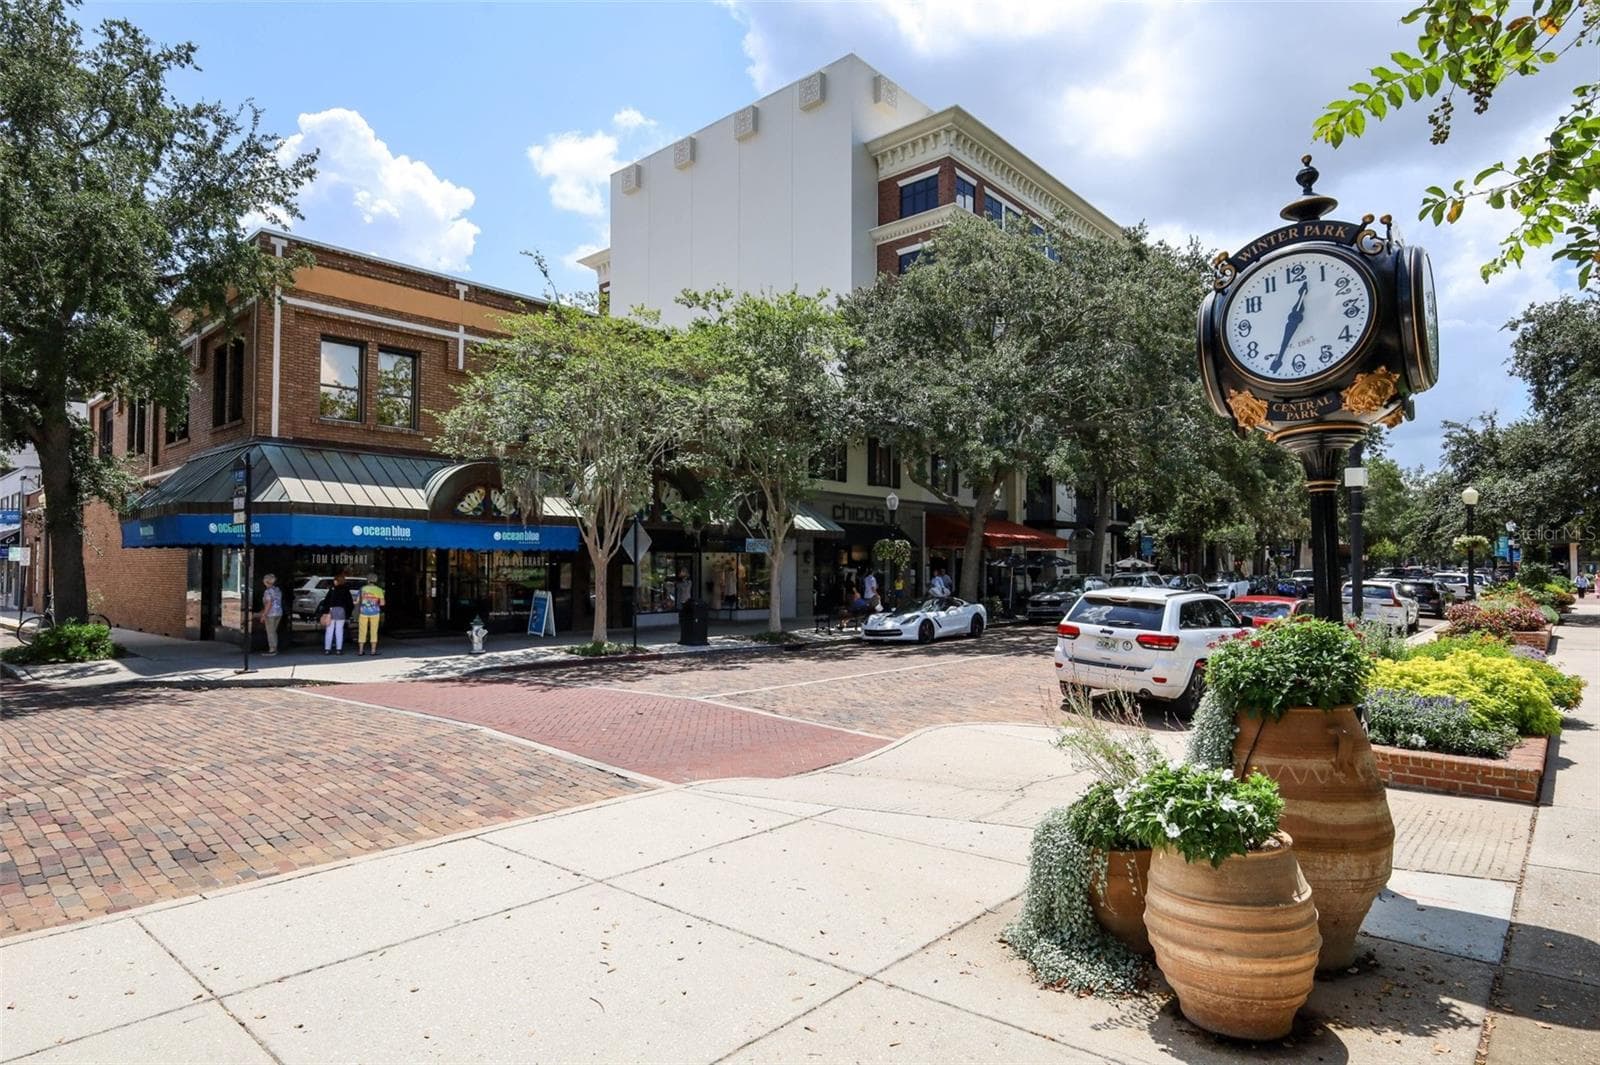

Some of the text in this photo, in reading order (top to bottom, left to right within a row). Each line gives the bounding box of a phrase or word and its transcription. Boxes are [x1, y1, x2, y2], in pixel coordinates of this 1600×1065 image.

[1238, 224, 1349, 261] WINTER PARK
[1286, 264, 1307, 284] 12
[1320, 265, 1326, 281] 1
[1265, 276, 1276, 293] 11
[1334, 277, 1352, 296] 2
[1342, 298, 1361, 318] 3
[1238, 319, 1252, 337] 9
[1337, 325, 1354, 342] 4
[1247, 341, 1259, 358] 8
[1319, 345, 1334, 363] 5
[1292, 354, 1306, 373] 6
[1272, 396, 1333, 412] CENTRAL
[1286, 409, 1319, 420] PARK
[832, 502, 885, 522] chico's
